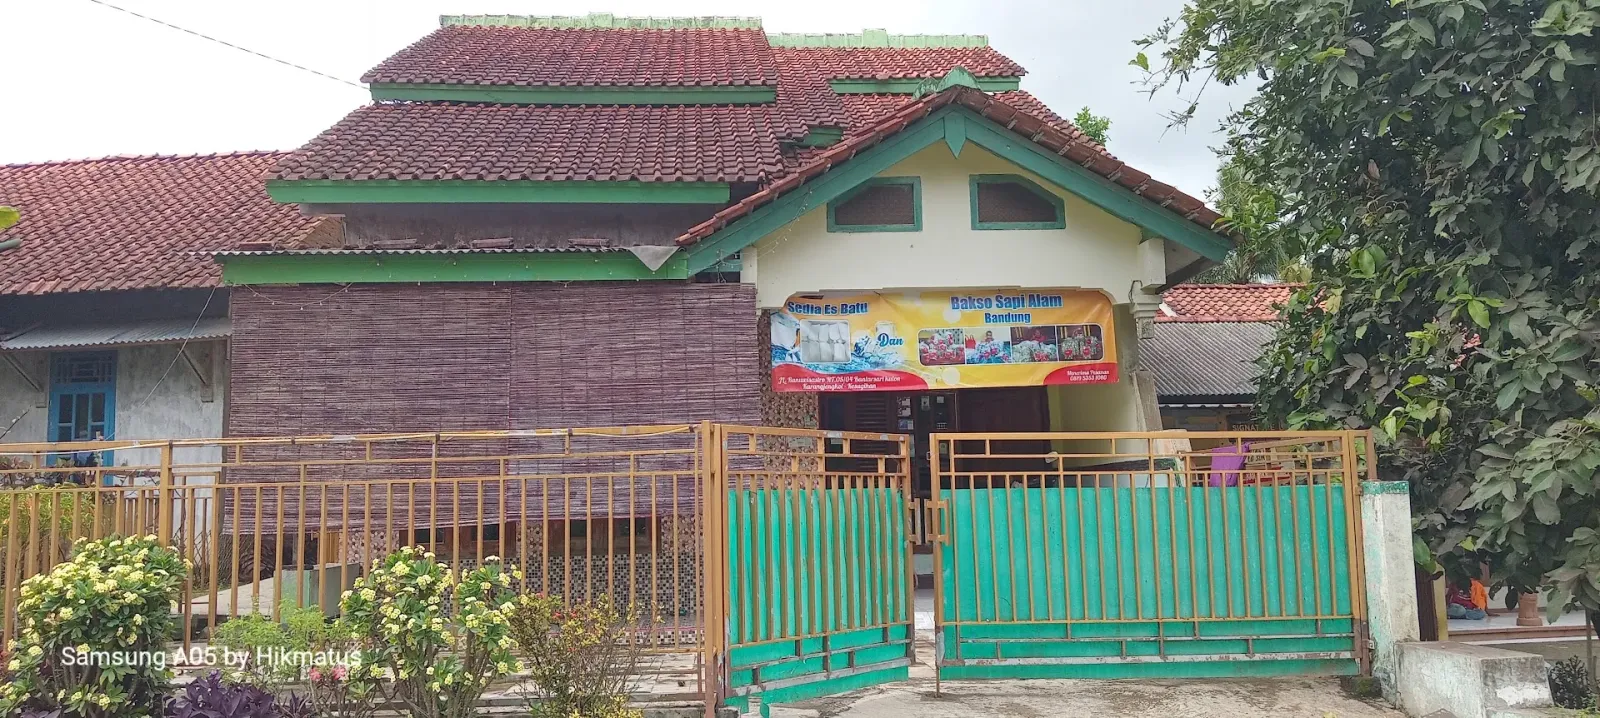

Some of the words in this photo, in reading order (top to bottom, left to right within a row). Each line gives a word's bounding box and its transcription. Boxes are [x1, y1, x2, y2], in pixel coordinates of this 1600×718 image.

[787, 302, 822, 315] Sedia
[824, 304, 838, 315] Es
[840, 302, 869, 315] Batu
[950, 296, 992, 310] Bakso
[995, 294, 1025, 310] Sapi
[1028, 294, 1062, 309] Alam
[984, 312, 1031, 324] Bandung
[878, 333, 903, 347] Dan
